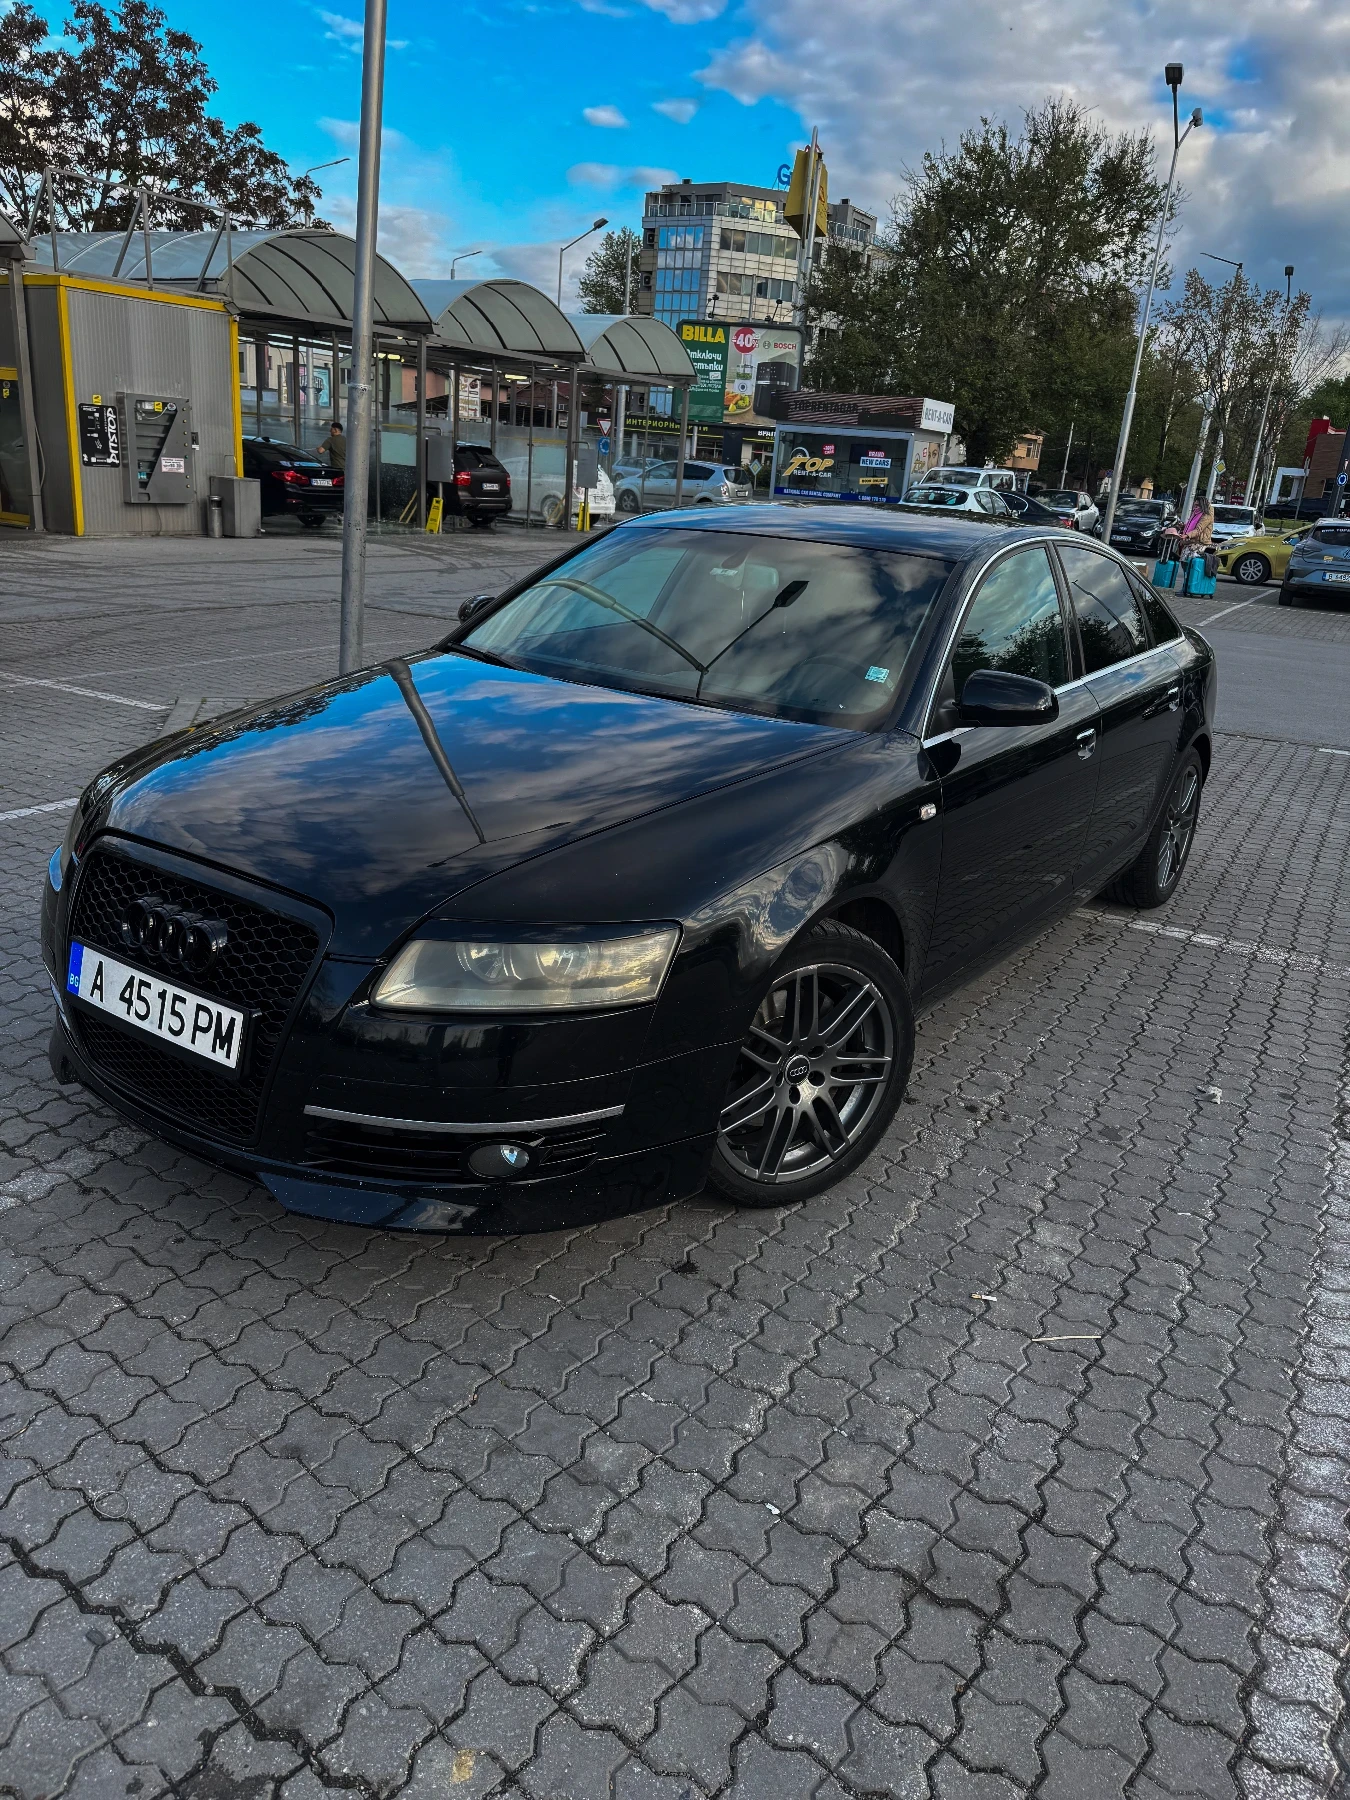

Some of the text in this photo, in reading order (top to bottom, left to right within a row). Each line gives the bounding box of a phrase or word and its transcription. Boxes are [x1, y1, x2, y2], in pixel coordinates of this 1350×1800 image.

[682, 325, 726, 344] BILLA
[773, 342, 797, 350] BOSCH
[694, 362, 723, 371] стъпки
[924, 408, 953, 425] RENT-A-CAR
[782, 456, 835, 477] TOP
[874, 459, 890, 467] CARS
[793, 469, 832, 478] RENT-A-CAR
[69, 973, 79, 988] BG
[90, 960, 104, 1004] A
